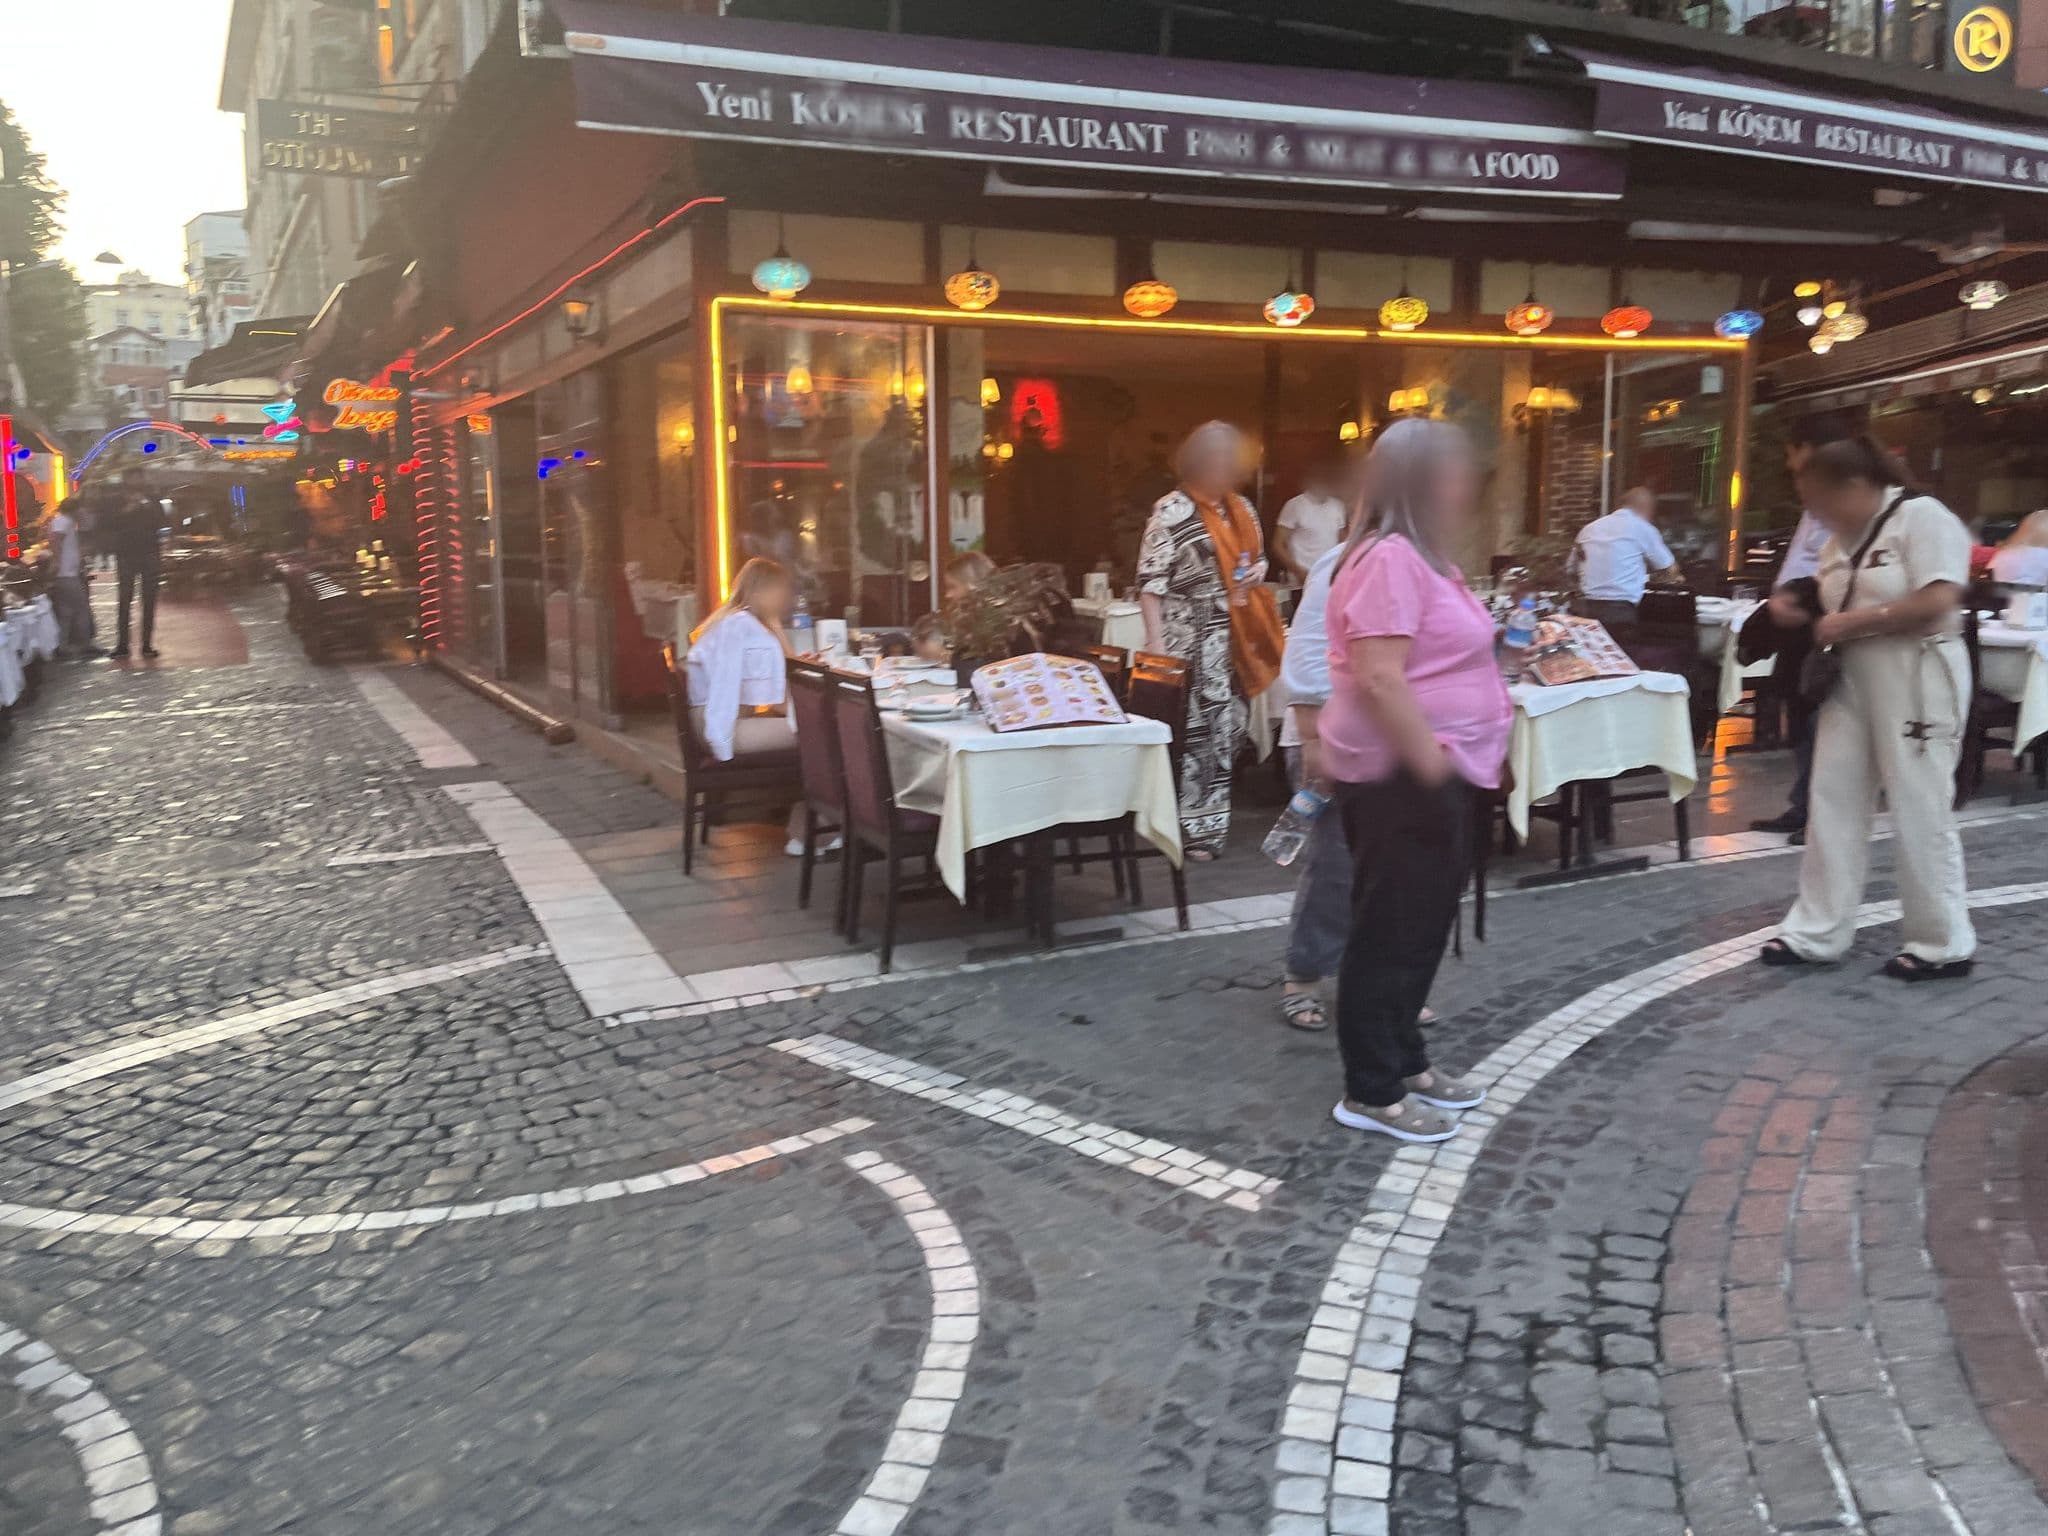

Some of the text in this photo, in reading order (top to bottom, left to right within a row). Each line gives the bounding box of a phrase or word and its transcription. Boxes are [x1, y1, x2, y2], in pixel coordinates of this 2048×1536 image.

[696, 82, 772, 121] Yeni
[952, 106, 1168, 153] RESTAURANT
[1664, 101, 1710, 131] Yeni
[1718, 104, 1802, 146] KÖŞEM
[1814, 123, 1955, 168] RESTAURANT
[2011, 156, 2030, 180] &
